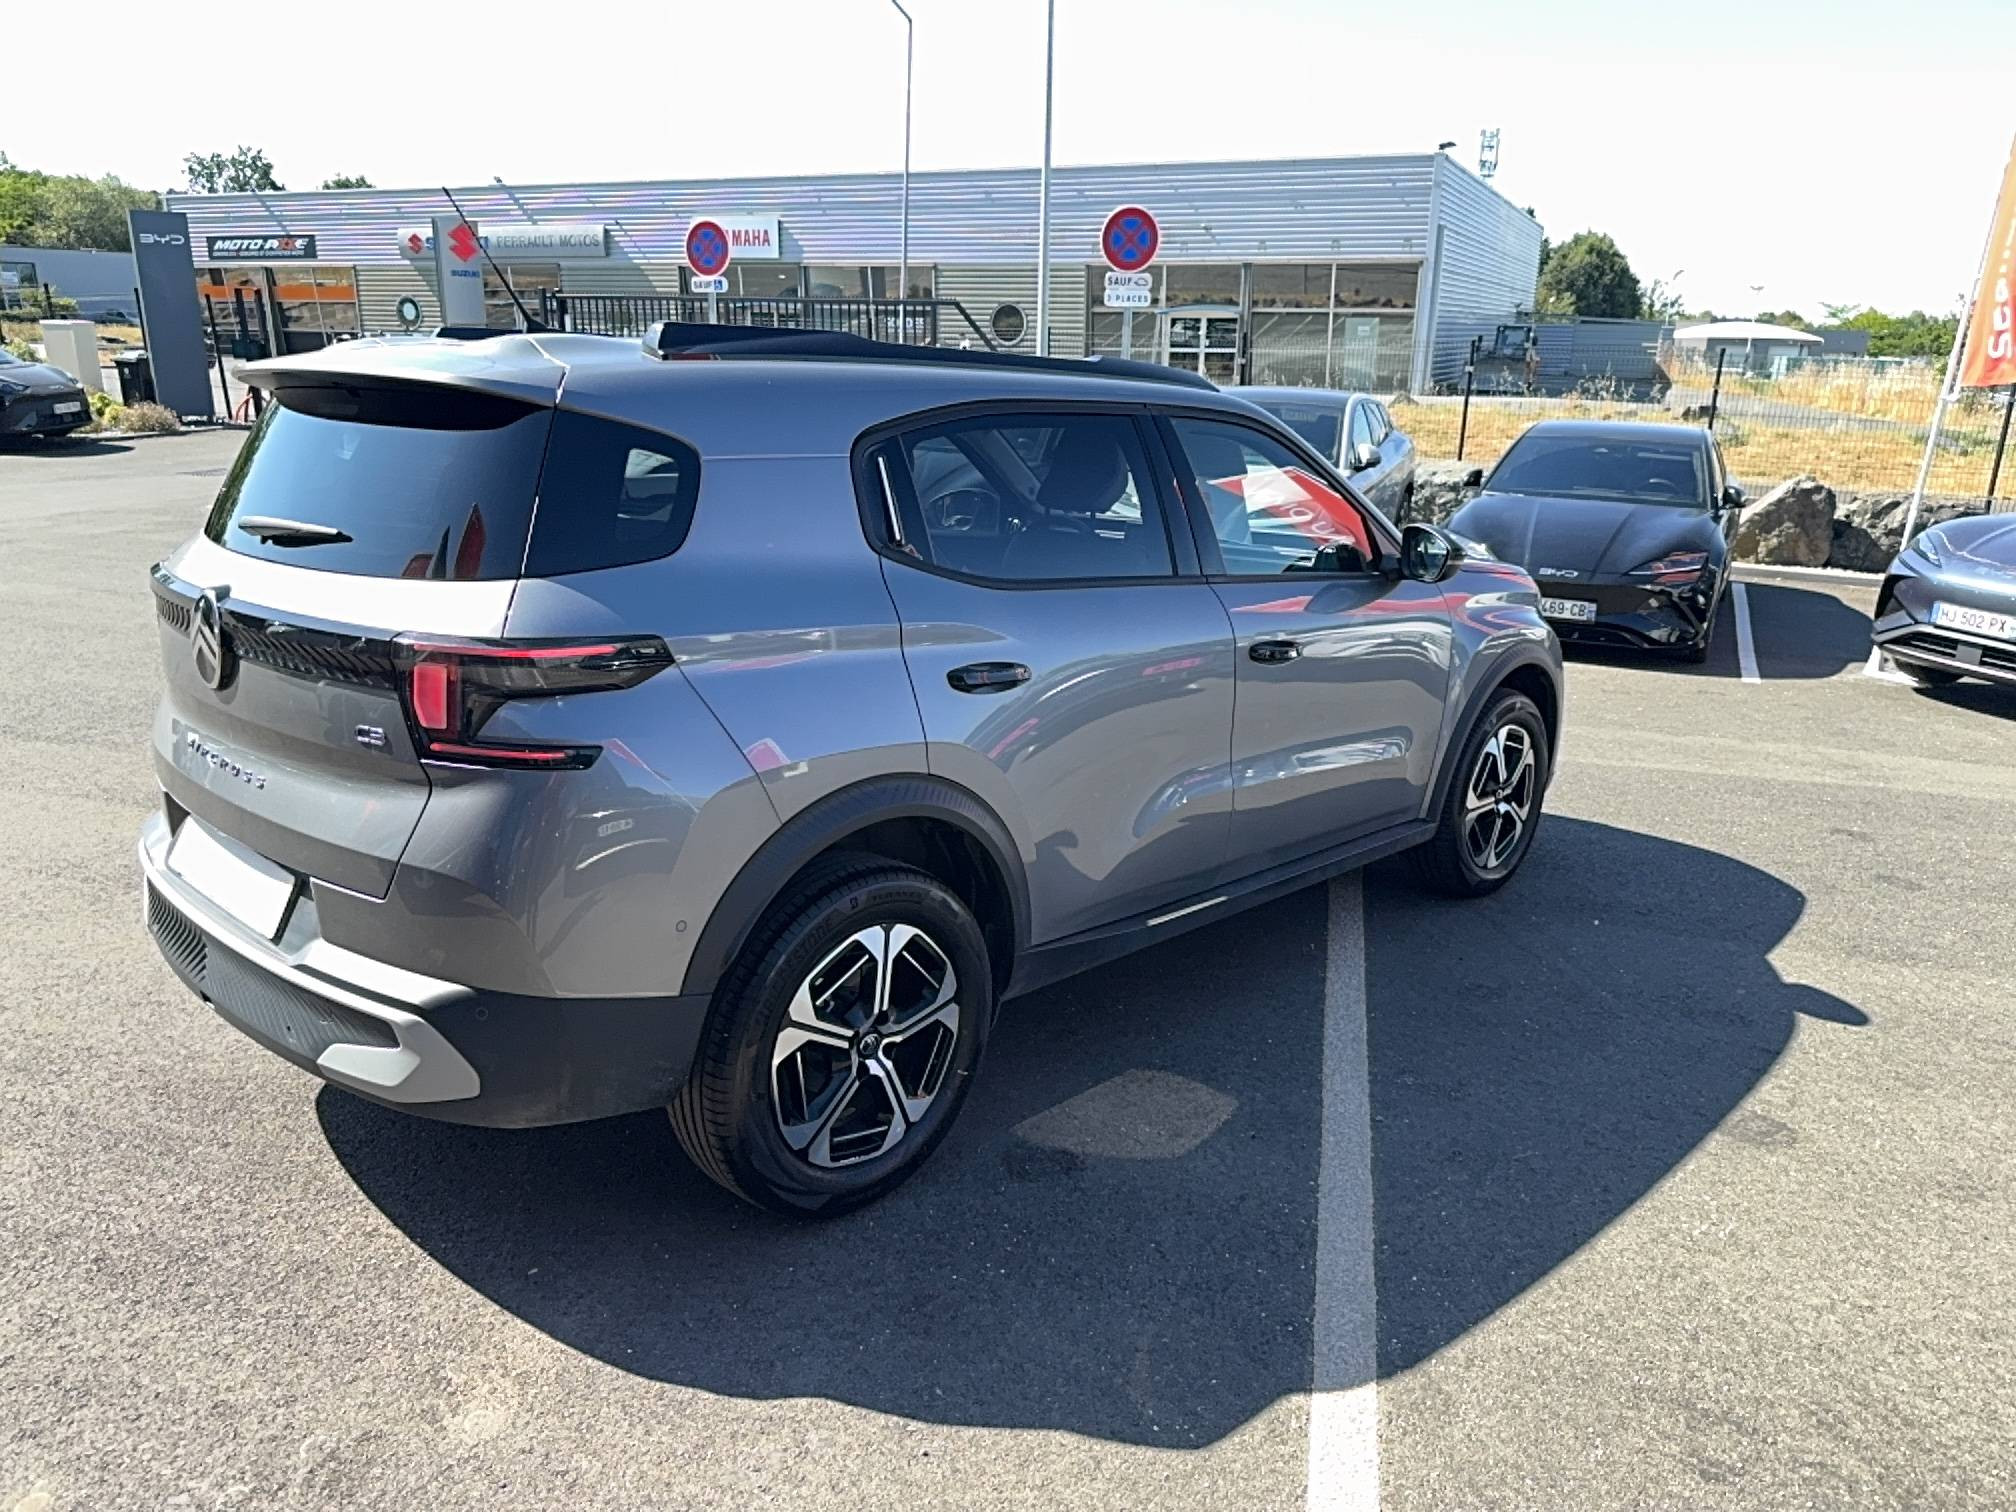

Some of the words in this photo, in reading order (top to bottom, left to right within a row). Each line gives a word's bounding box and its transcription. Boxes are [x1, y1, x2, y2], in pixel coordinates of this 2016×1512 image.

[139, 233, 185, 245] BYD
[559, 234, 600, 247] MOTOS
[726, 229, 771, 247] MAHA
[1107, 276, 1132, 287] SAUF
[1115, 294, 1149, 303] PLACES
[1538, 567, 1579, 578] BYD
[1960, 611, 1985, 629] 502
[1989, 617, 2007, 633] PX
[186, 737, 267, 791] AIRCROSS
